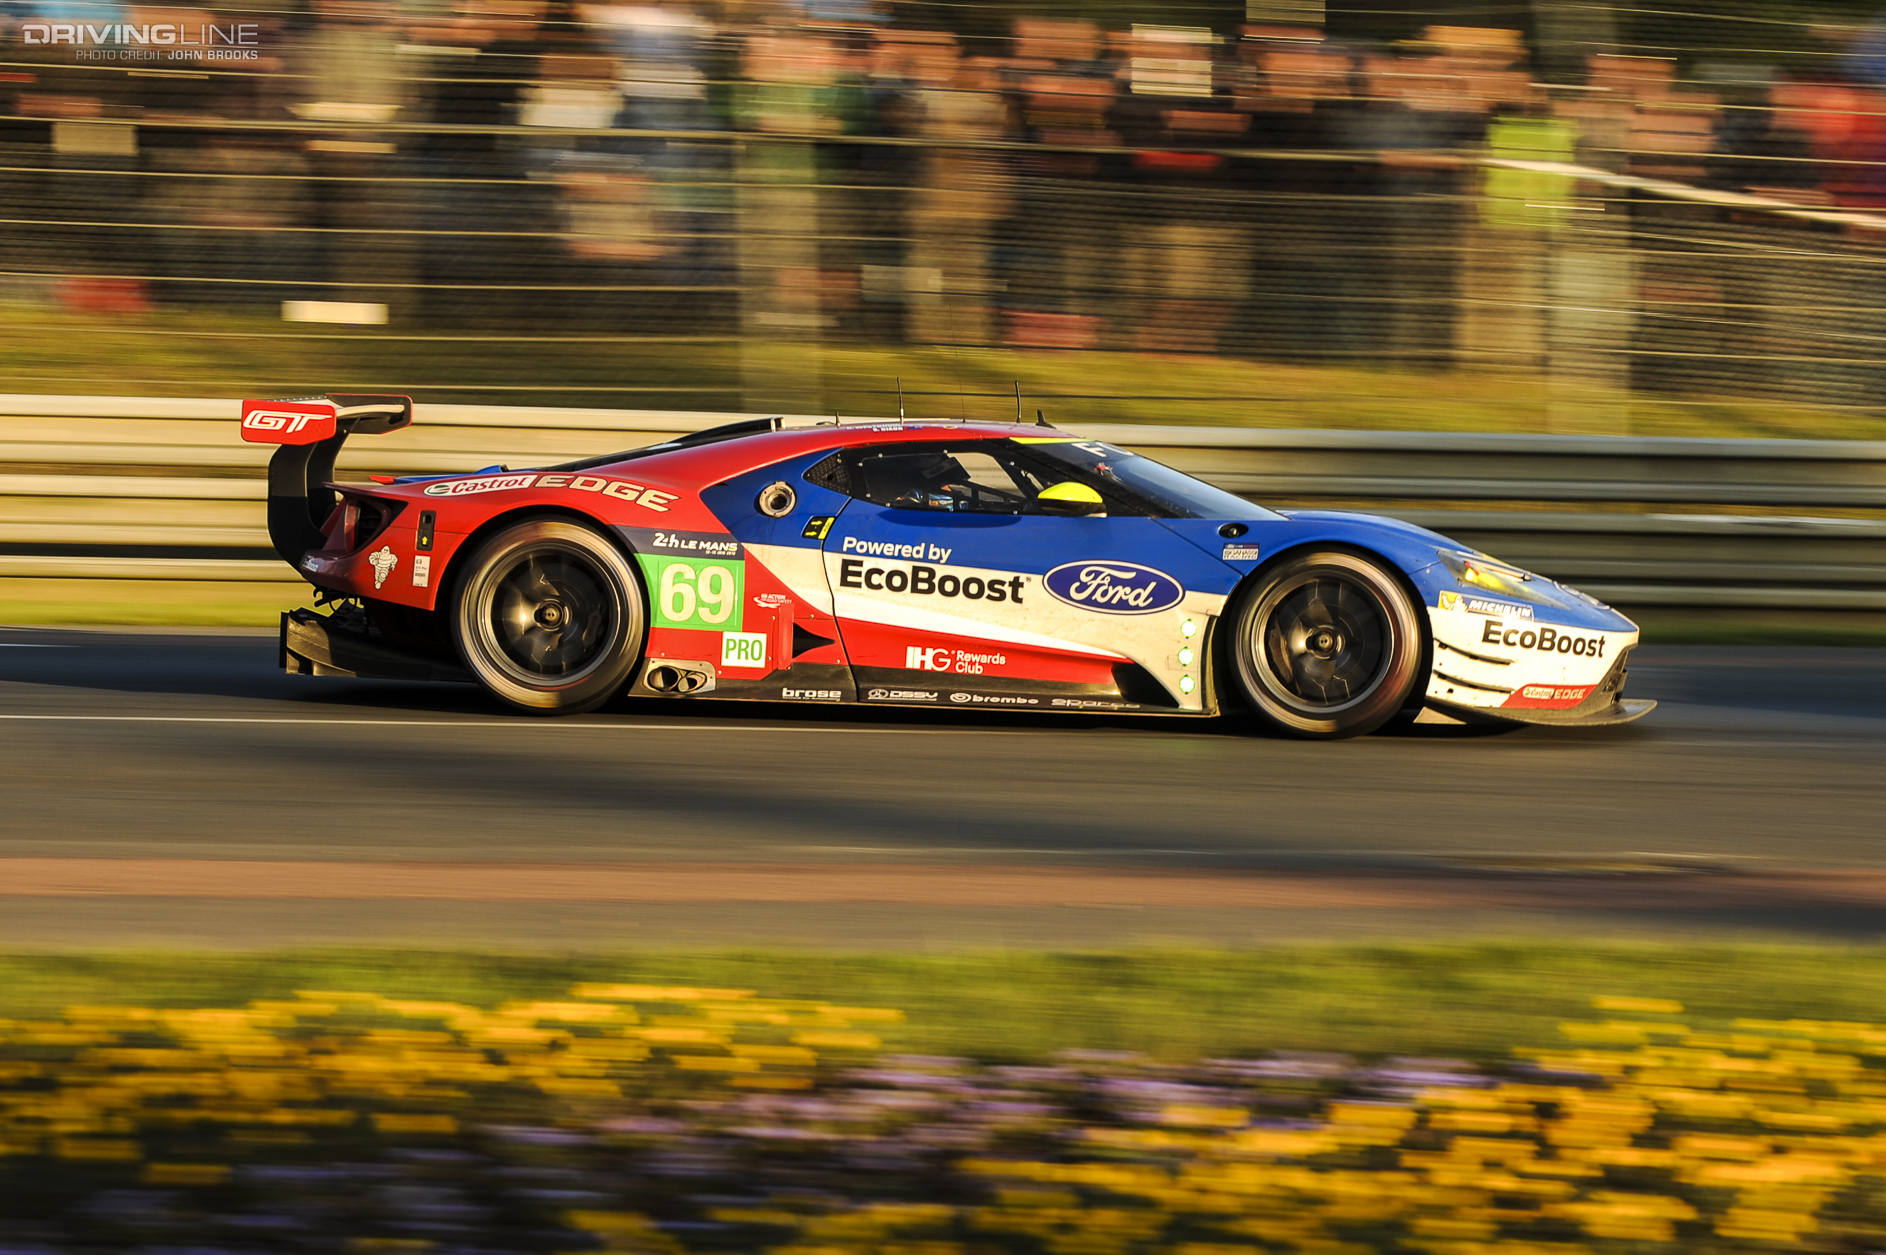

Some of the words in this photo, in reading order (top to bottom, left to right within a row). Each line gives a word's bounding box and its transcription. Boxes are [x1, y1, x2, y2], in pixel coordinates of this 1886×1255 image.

[243, 410, 332, 433] GT
[452, 476, 530, 494] Castrol
[534, 474, 681, 512] EDGE
[681, 539, 698, 549] LE
[698, 541, 738, 551] MANS
[843, 536, 926, 559] Powered
[928, 543, 952, 564] by
[659, 562, 735, 624] 69
[1069, 565, 1157, 608] Ford
[1468, 600, 1531, 617] MICHELIN
[725, 638, 763, 661] PRO
[1482, 620, 1606, 658] EcoBoost
[906, 646, 951, 671] IHG
[955, 661, 984, 674] Club
[956, 650, 1006, 665] Rewards
[782, 687, 841, 698] brose
[972, 694, 1039, 704] brembo
[1554, 688, 1586, 699] EDGE
